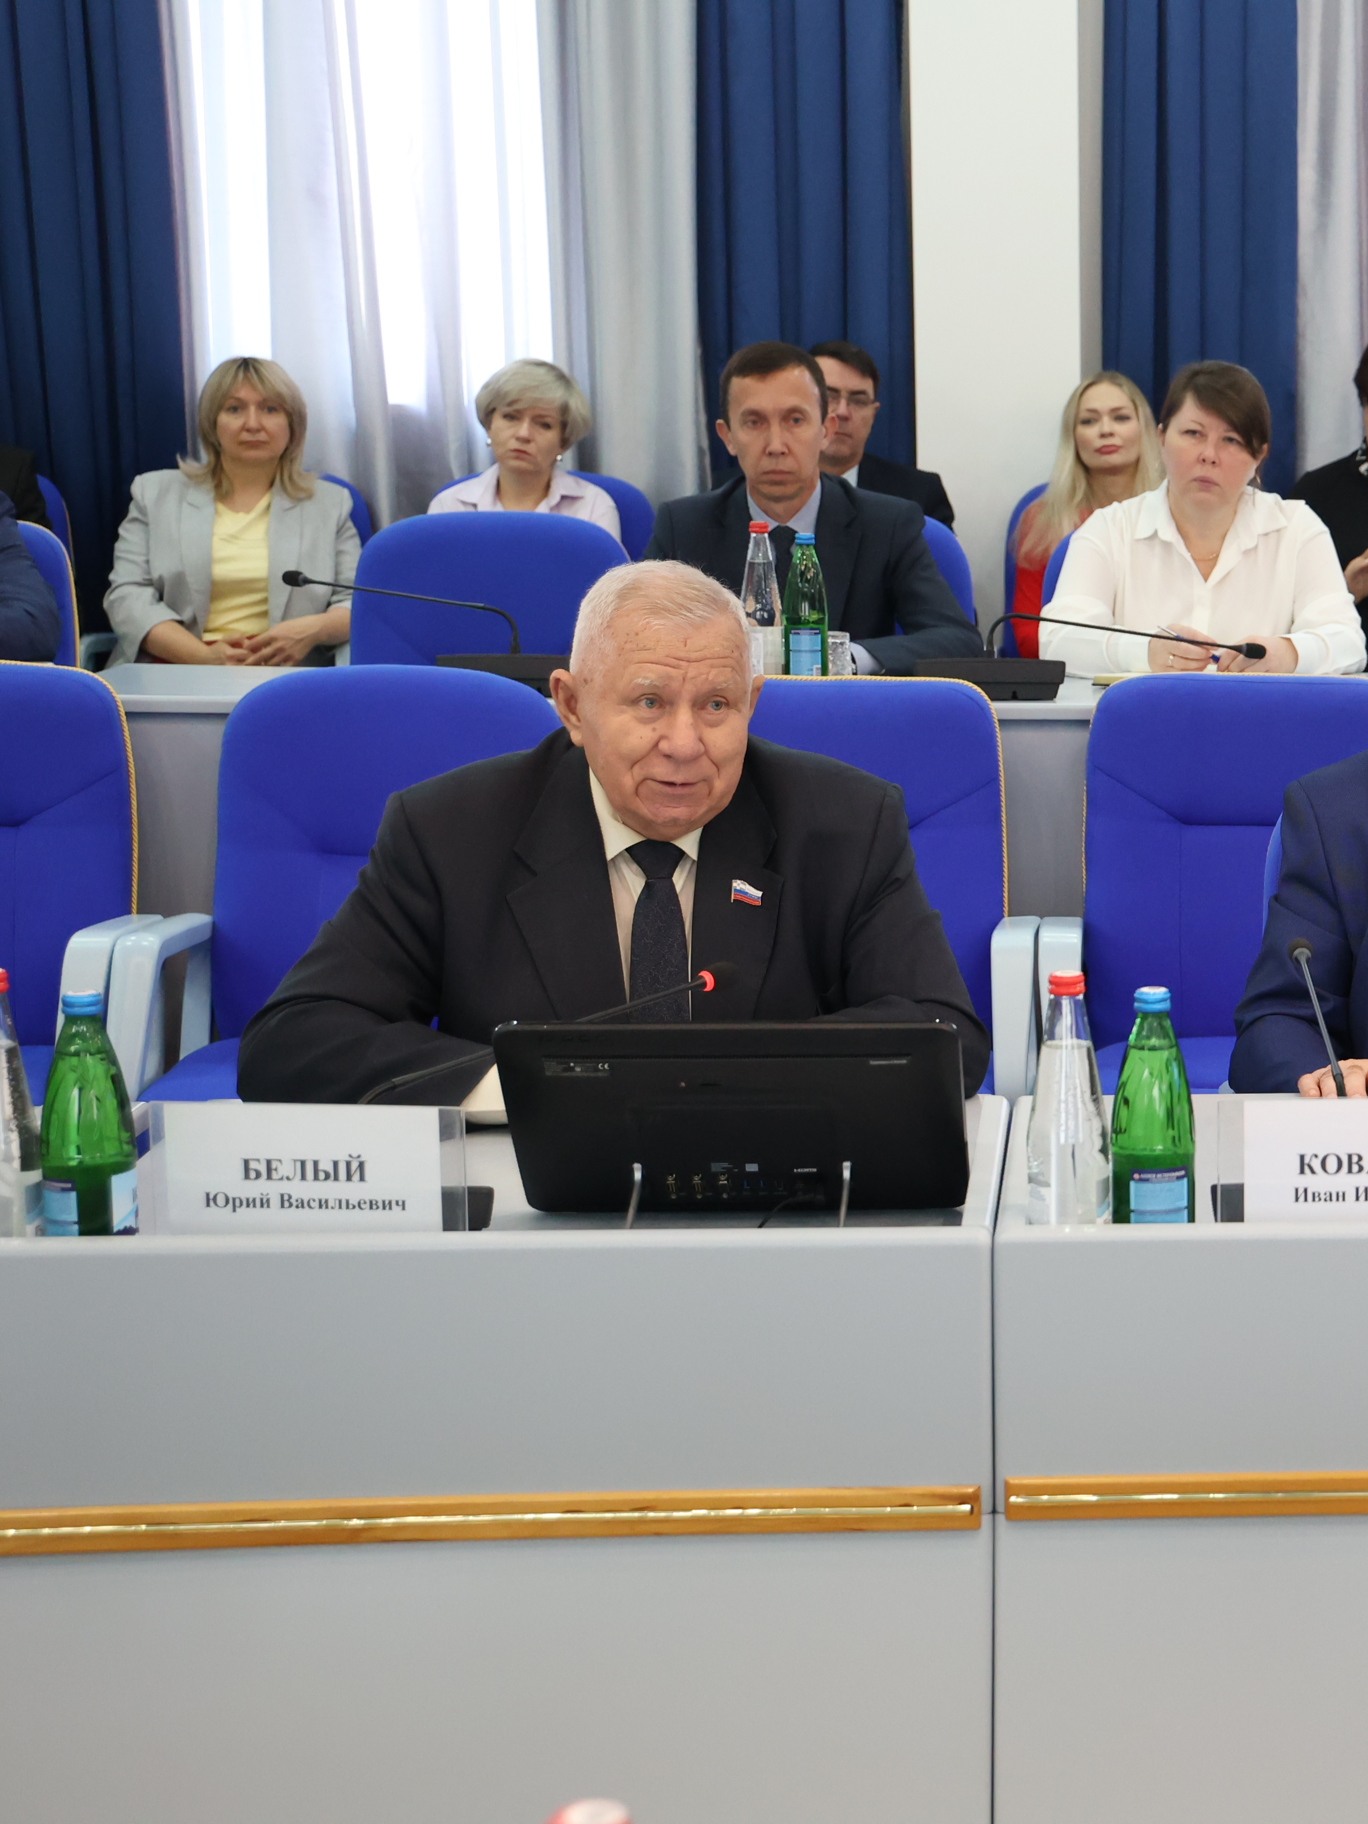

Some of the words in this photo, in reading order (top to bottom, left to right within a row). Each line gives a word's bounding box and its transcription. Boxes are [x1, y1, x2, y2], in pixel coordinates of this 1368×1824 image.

[241, 1153, 368, 1182] БЕЛЫЙ
[204, 1191, 271, 1213] Юрий
[279, 1192, 407, 1211] Васильевич
[1293, 1186, 1346, 1203] Иван
